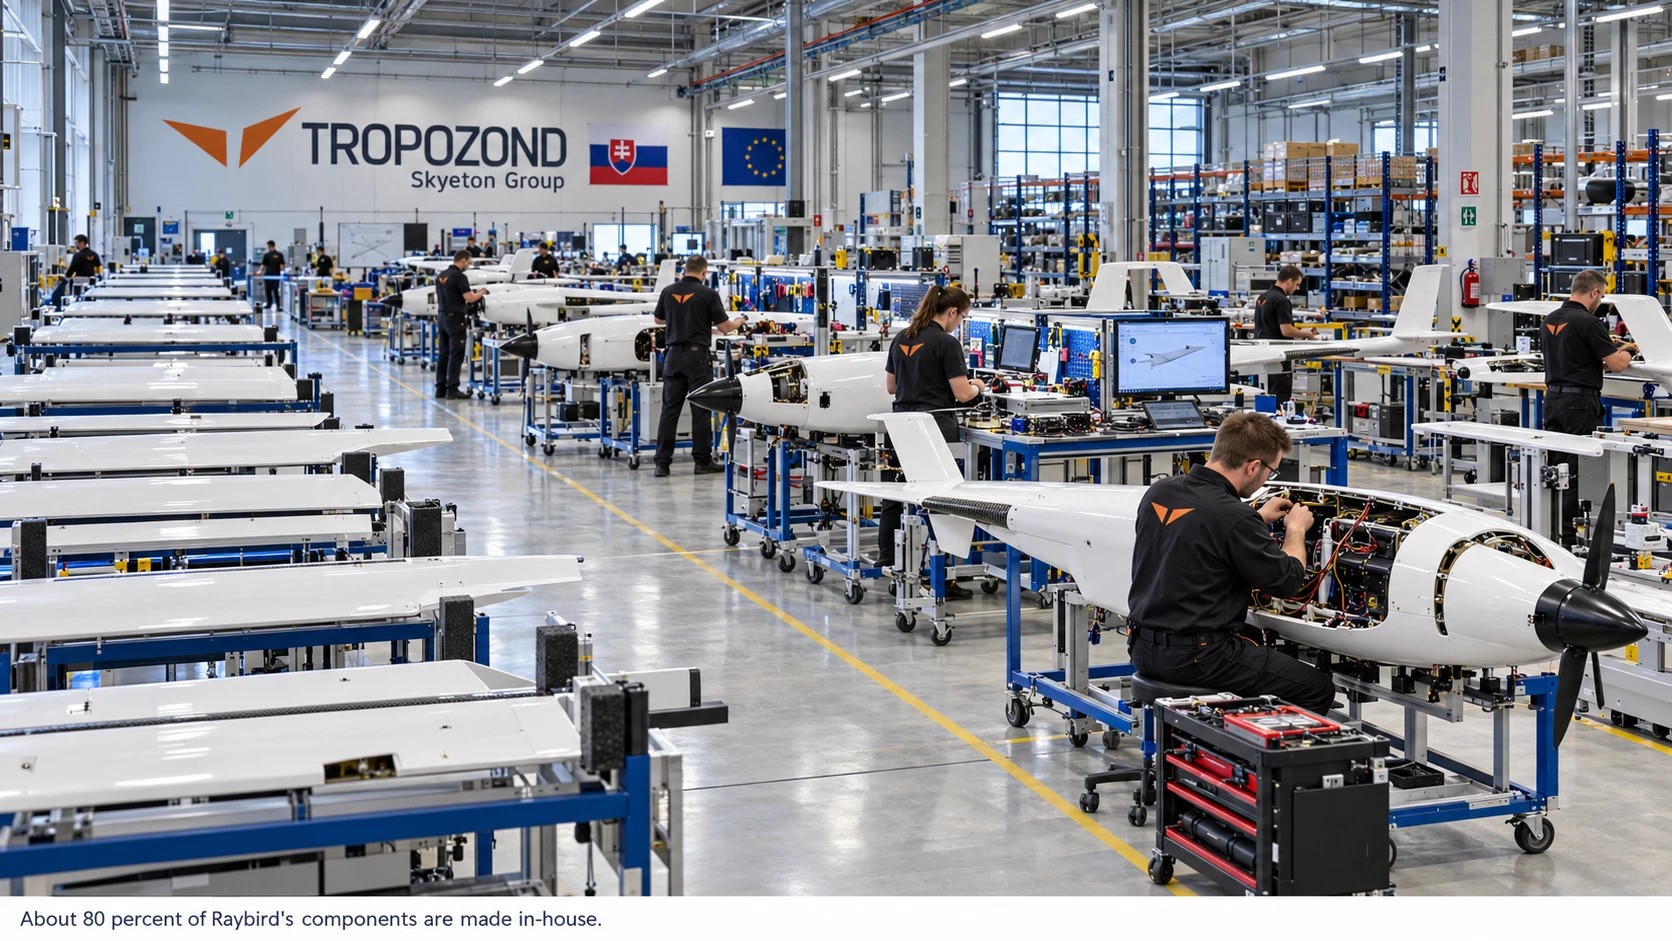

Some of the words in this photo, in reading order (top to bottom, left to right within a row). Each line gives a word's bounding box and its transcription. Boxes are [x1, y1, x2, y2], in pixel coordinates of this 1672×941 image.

[303, 122, 567, 167] TROPOZOND
[412, 171, 495, 192] Skyeton
[505, 172, 564, 193] Group
